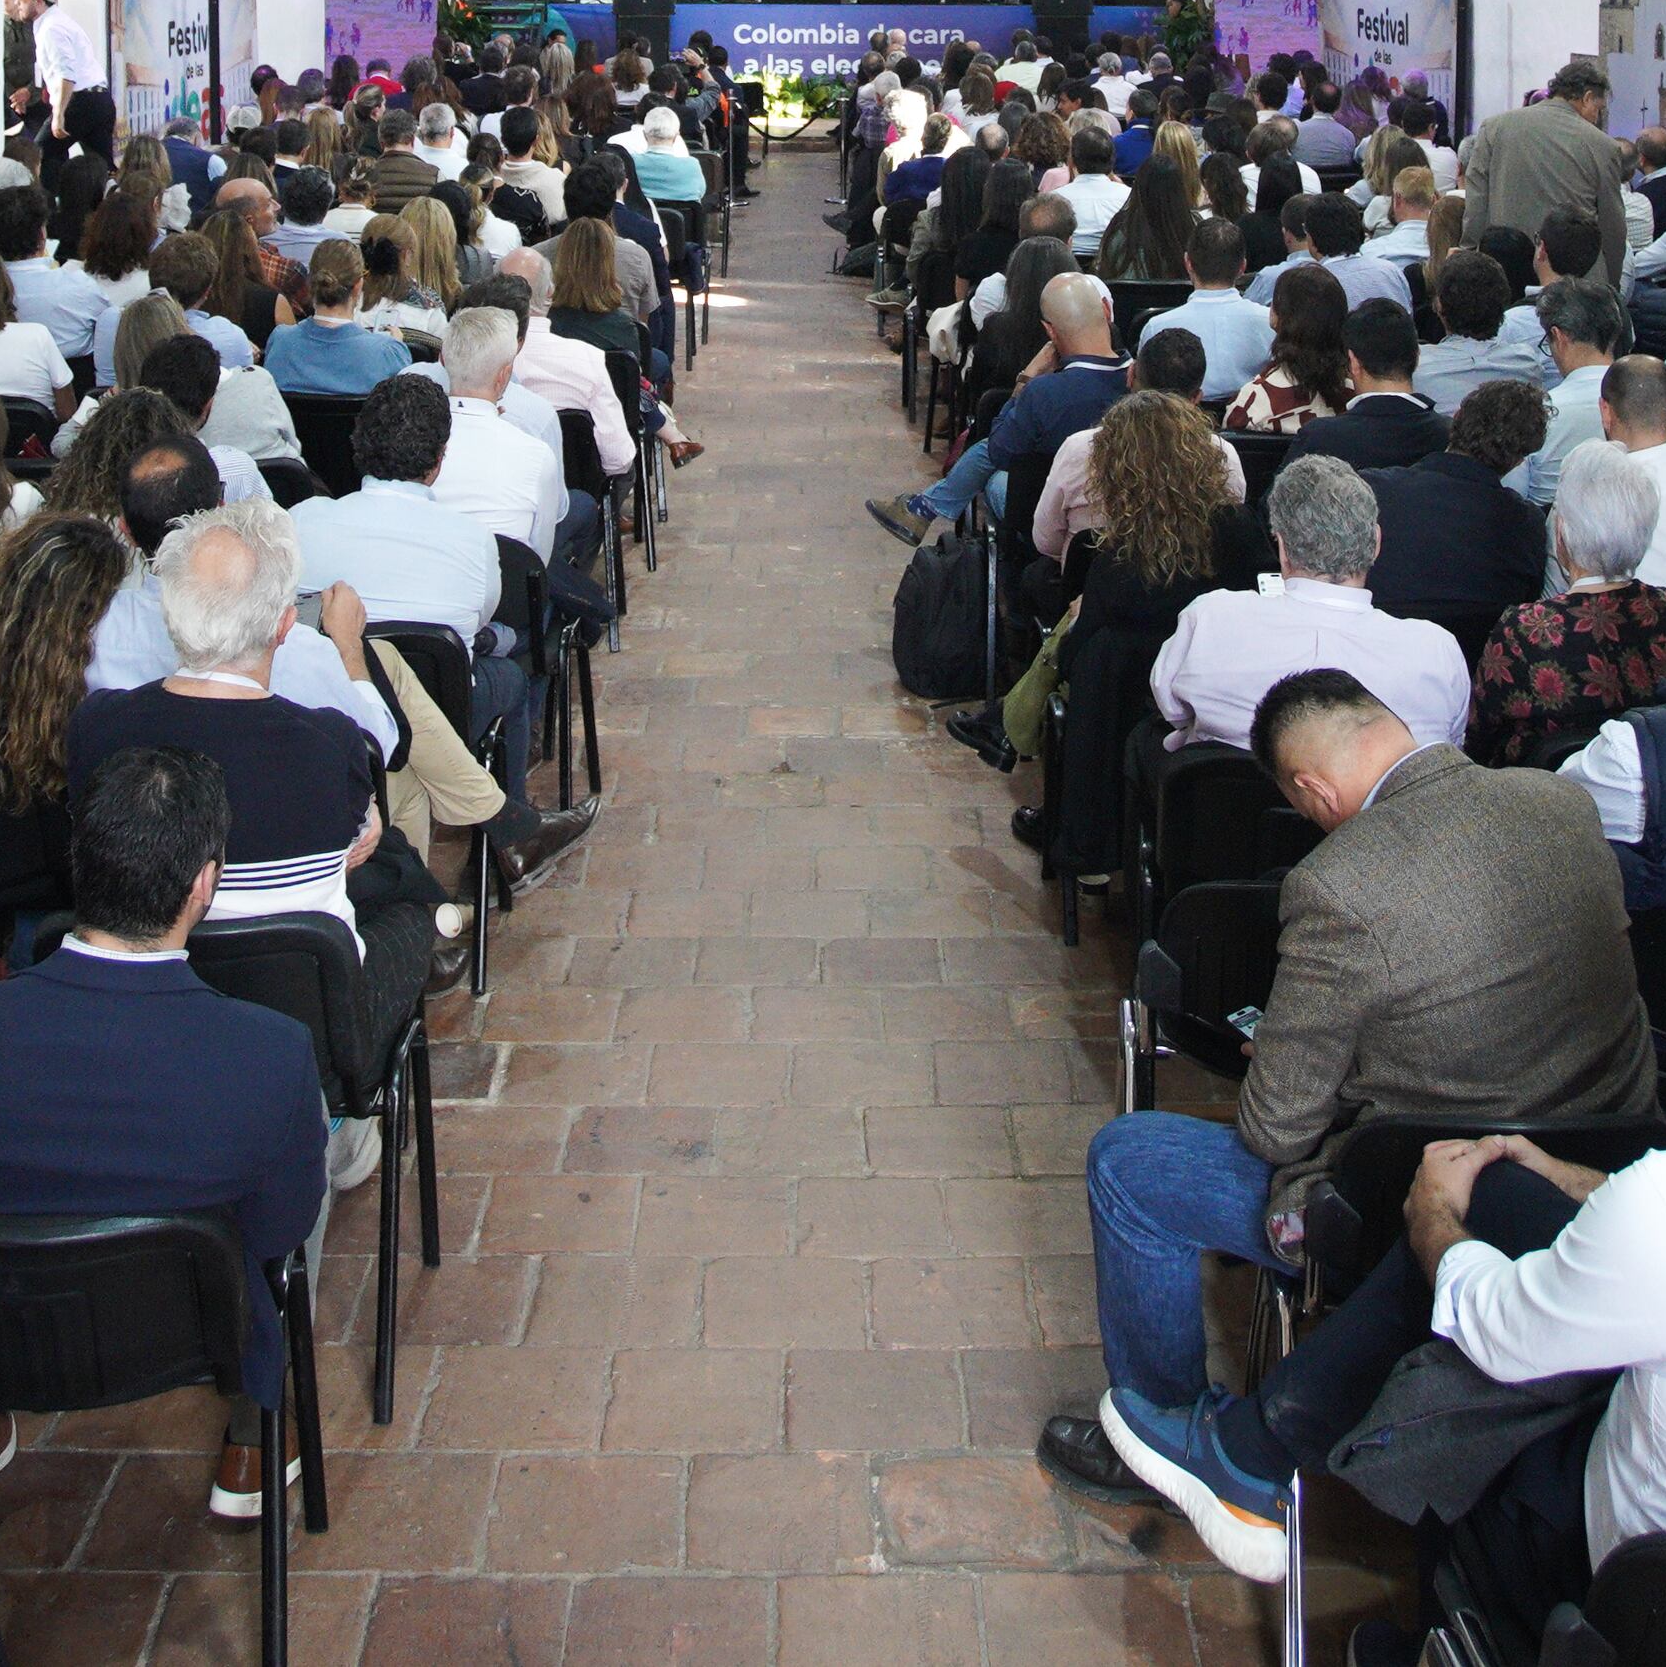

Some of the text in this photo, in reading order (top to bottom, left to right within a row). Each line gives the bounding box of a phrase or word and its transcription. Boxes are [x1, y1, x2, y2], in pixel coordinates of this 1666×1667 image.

[168, 12, 209, 58] Festiv
[733, 22, 859, 45] Colombia
[908, 28, 965, 45] cara
[1357, 7, 1409, 46] Festival
[744, 58, 759, 75] a
[767, 54, 804, 75] las
[1374, 47, 1392, 65] de las
